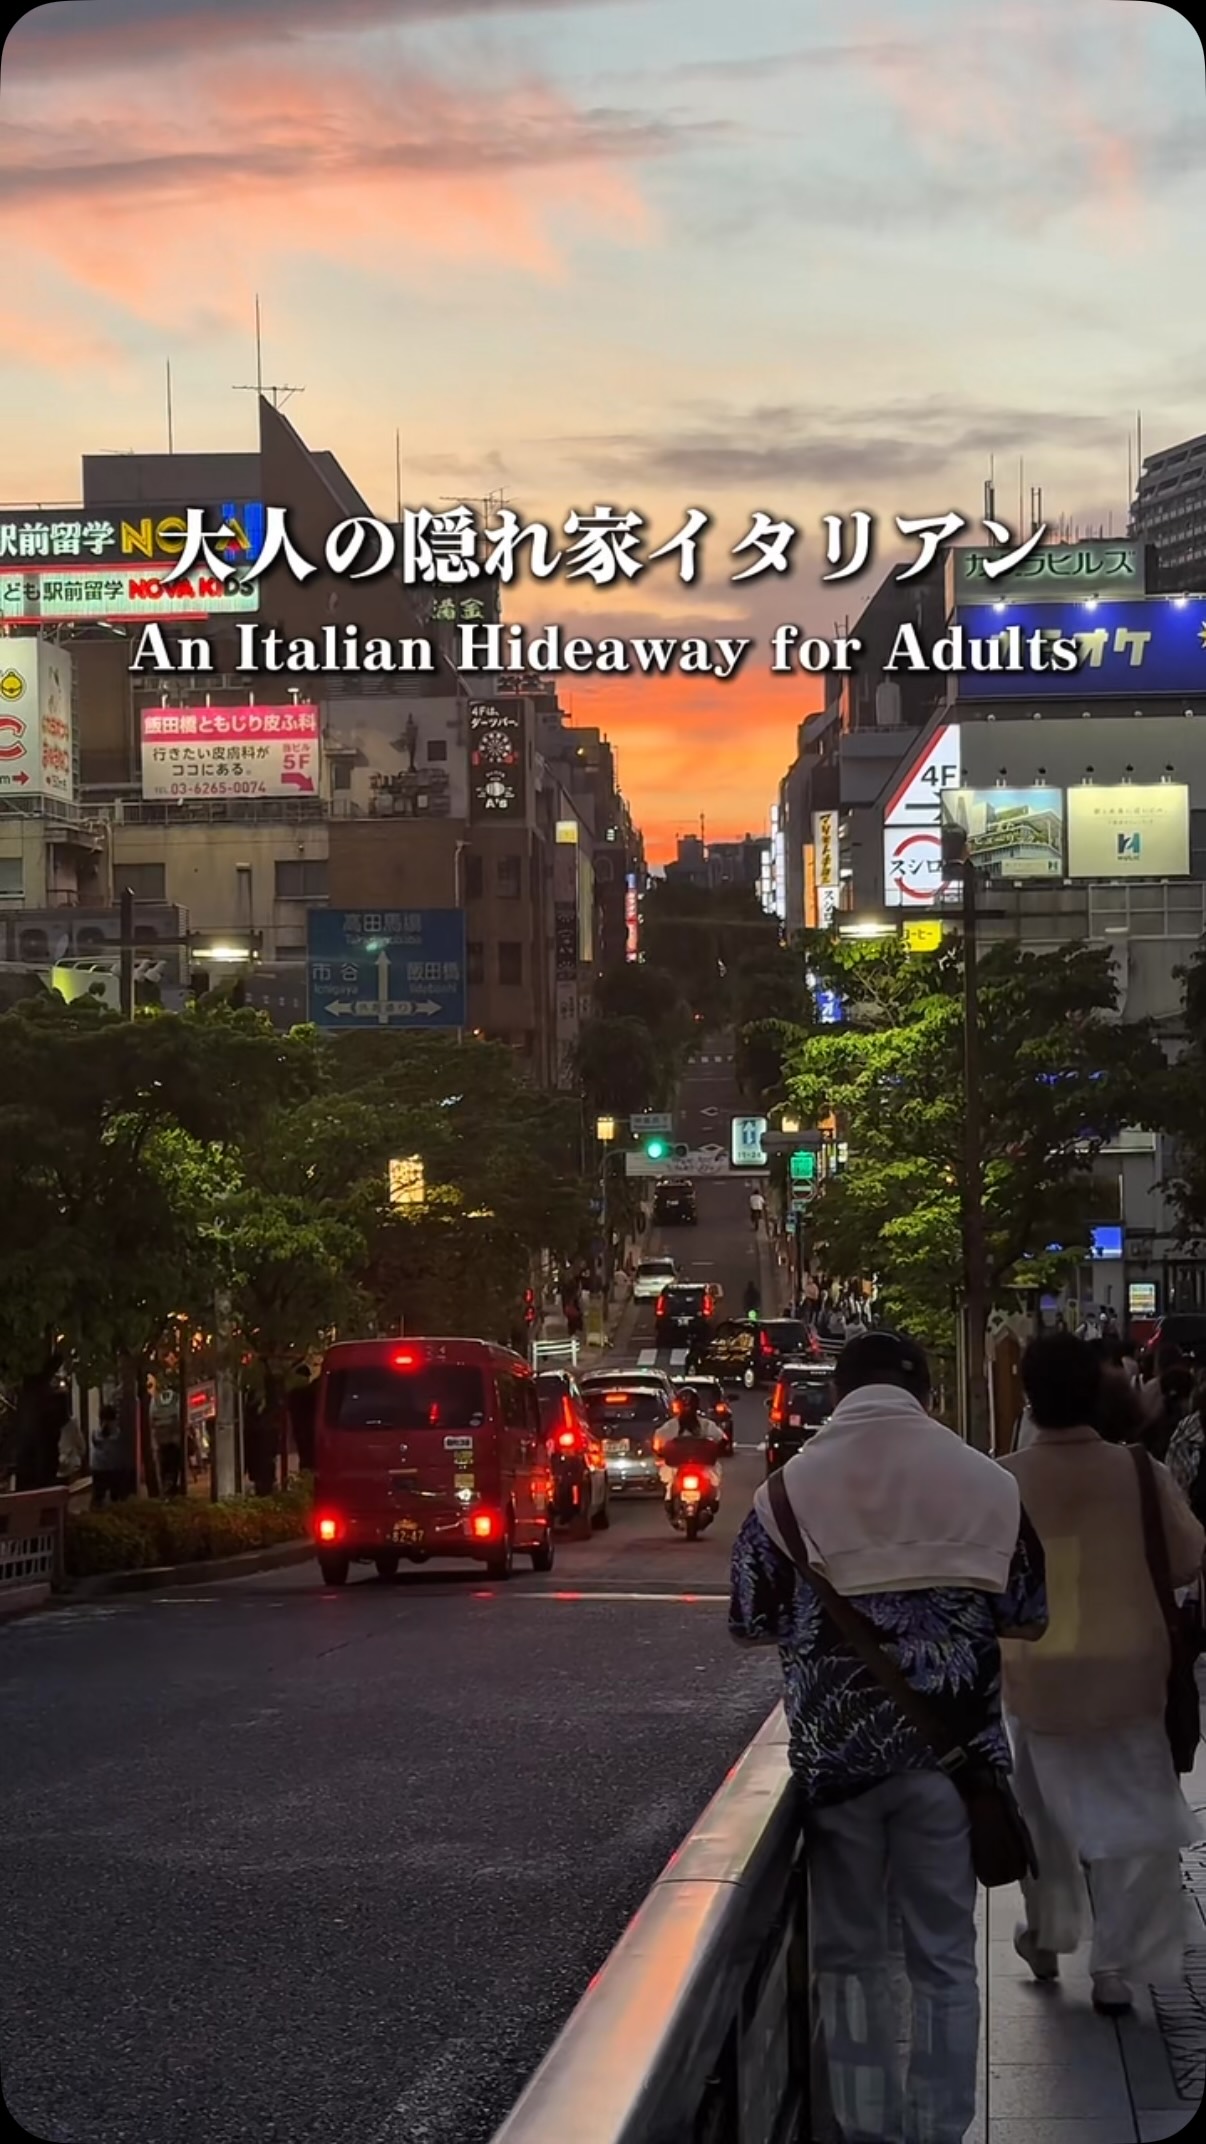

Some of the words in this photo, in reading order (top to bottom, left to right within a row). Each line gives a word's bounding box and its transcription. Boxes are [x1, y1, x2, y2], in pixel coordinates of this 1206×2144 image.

[121, 517, 250, 558] NOA
[965, 551, 1136, 578] カラヒルズ
[129, 577, 194, 600] NOVA
[283, 754, 310, 770] 5F
[921, 764, 957, 787] 4F
[171, 781, 267, 795] 03-6265-0074
